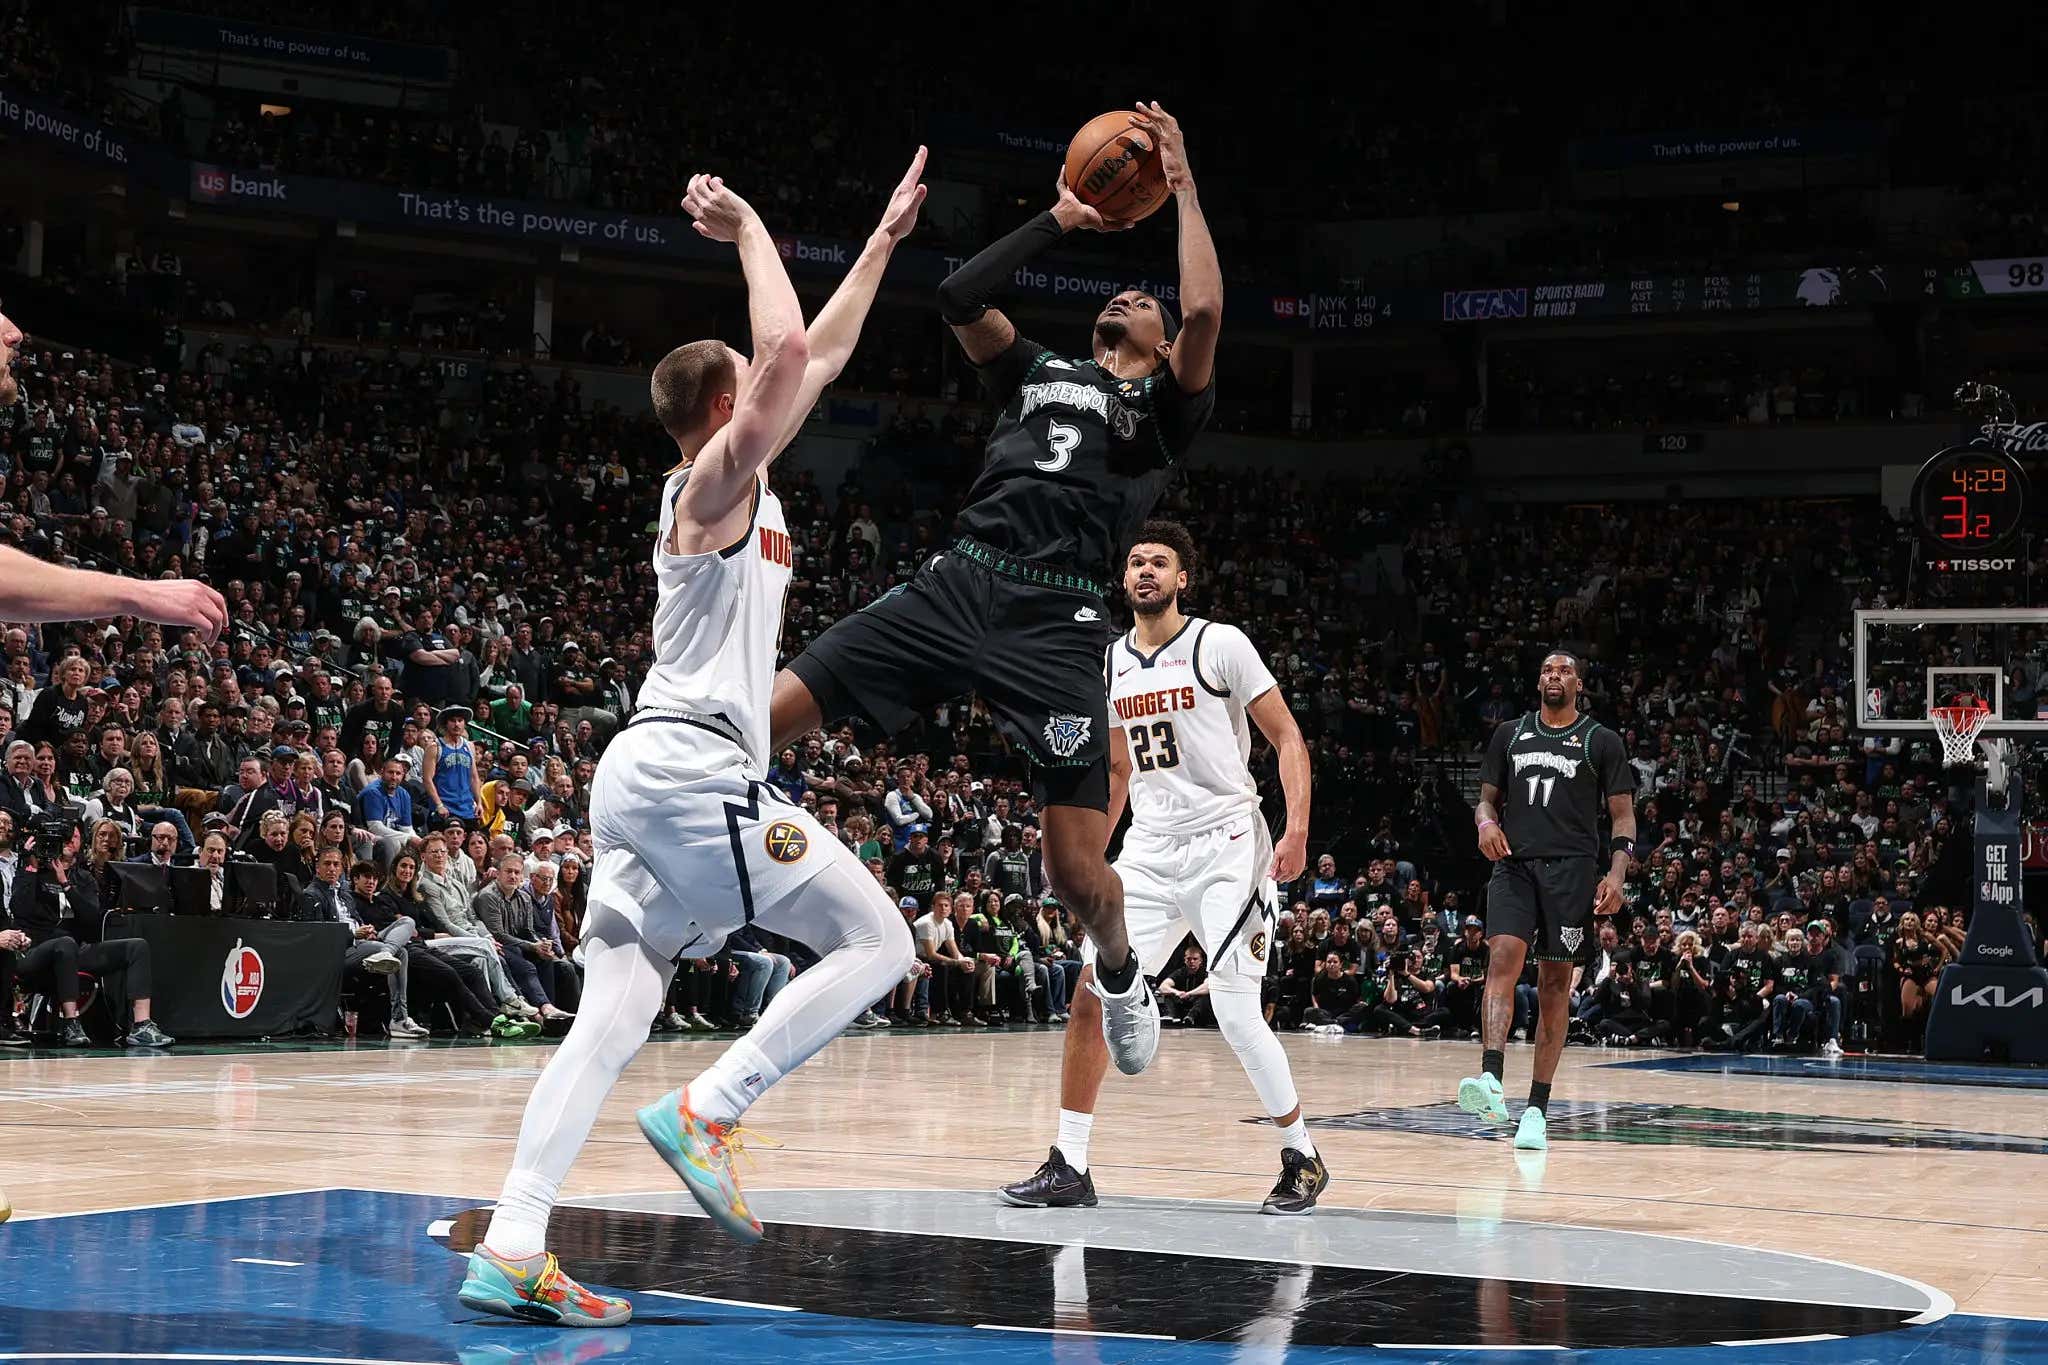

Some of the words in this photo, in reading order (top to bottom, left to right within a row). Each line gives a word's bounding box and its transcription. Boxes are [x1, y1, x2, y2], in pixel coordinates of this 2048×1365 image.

[218, 29, 260, 47] That's
[264, 35, 285, 50] the
[288, 40, 330, 58] power
[334, 45, 349, 59] of
[0, 90, 19, 121] he
[24, 106, 80, 144] power
[83, 129, 103, 152] of
[105, 140, 128, 164] us.
[1652, 143, 1691, 157] That's
[1695, 138, 1716, 154] the
[1719, 139, 1761, 156] power
[1764, 136, 1779, 149] of
[200, 174, 225, 192] us
[231, 173, 287, 200] bank
[398, 192, 470, 222] That's
[477, 203, 516, 228] the
[522, 212, 599, 237] power
[603, 218, 629, 241] of
[635, 227, 667, 245] us.
[796, 241, 847, 264] bank
[1015, 264, 1048, 288] the
[1054, 273, 1121, 296] power
[2008, 263, 2044, 288] 98
[1534, 285, 1572, 301] SPORTS
[1573, 282, 1605, 299] RADIO
[1961, 281, 1971, 295] 5
[1318, 297, 1347, 312] NYK
[1443, 288, 1528, 321] KFAN
[1533, 302, 1548, 318] FM
[1317, 313, 1350, 328] ATL
[438, 361, 468, 377] 116
[1019, 381, 1148, 441] TIMBERWOLVES
[1034, 417, 1083, 473] 3
[1659, 435, 1687, 450] 120
[1952, 469, 2006, 493] 4:29
[1950, 559, 2016, 571] TISSOT
[1162, 659, 1187, 669] ibotta
[1114, 686, 1195, 721] NUGGETS
[1129, 721, 1180, 773] 23
[1525, 774, 1556, 807] 11
[1986, 844, 2008, 863] GET
[1985, 863, 2009, 881] THE
[1991, 882, 2014, 904] App
[1977, 944, 2014, 958] Google
